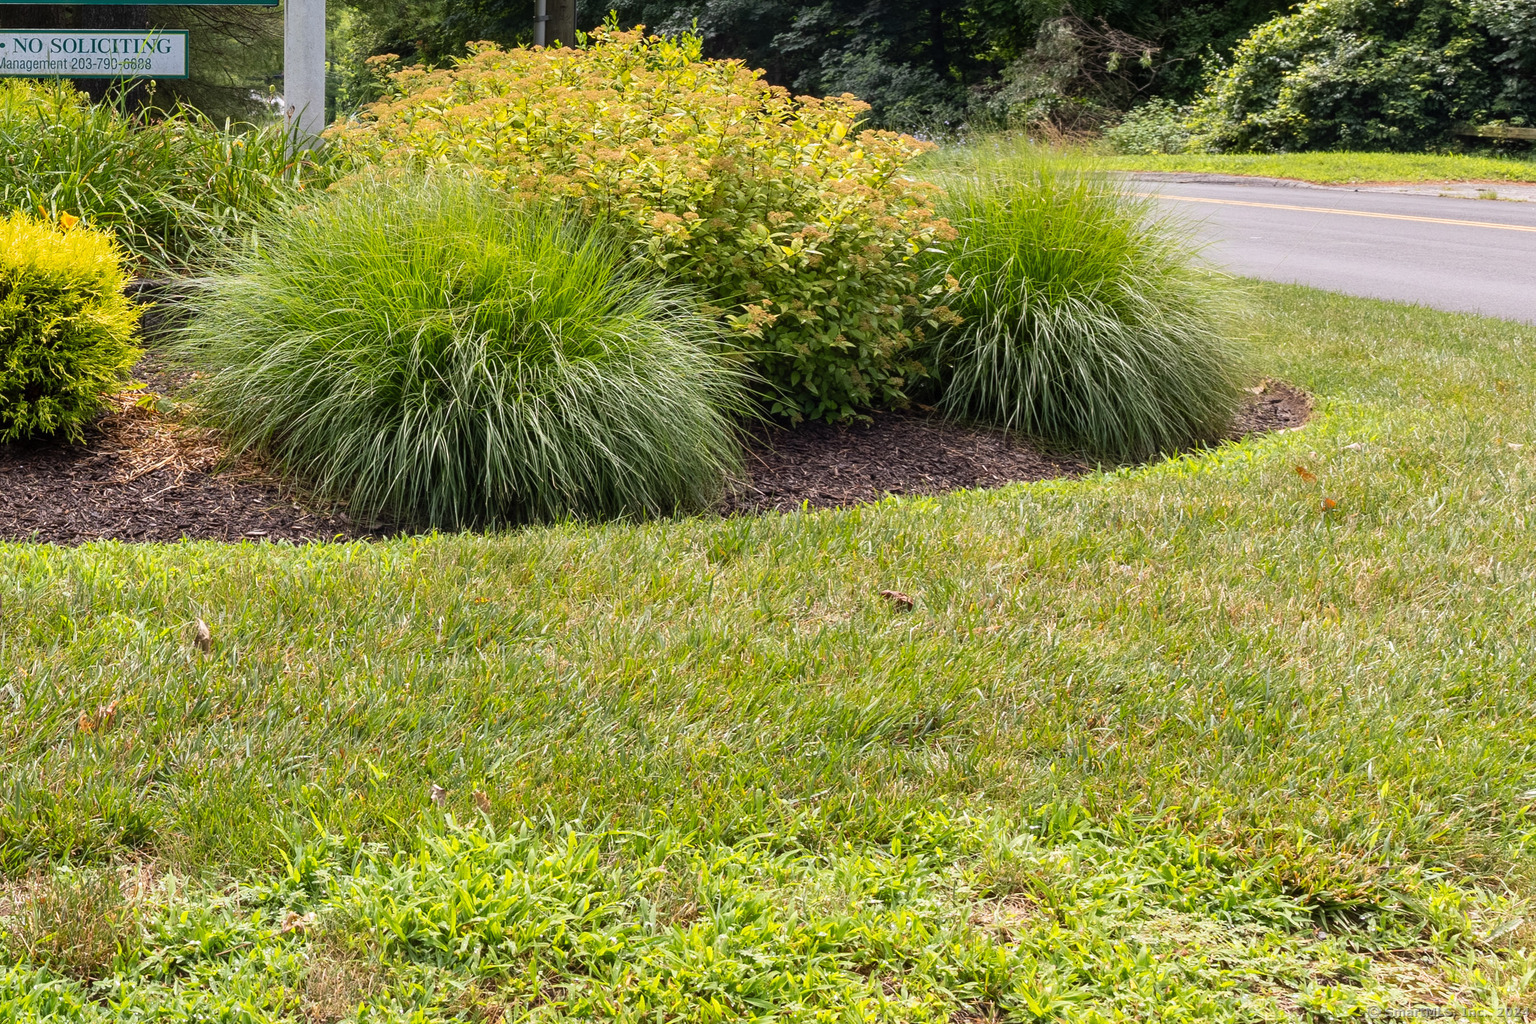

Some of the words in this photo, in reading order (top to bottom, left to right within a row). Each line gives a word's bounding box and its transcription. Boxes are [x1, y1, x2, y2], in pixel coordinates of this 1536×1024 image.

[12, 37, 43, 54] NO
[50, 37, 172, 55] SOLICITING
[71, 57, 152, 71] 203-790-6888
